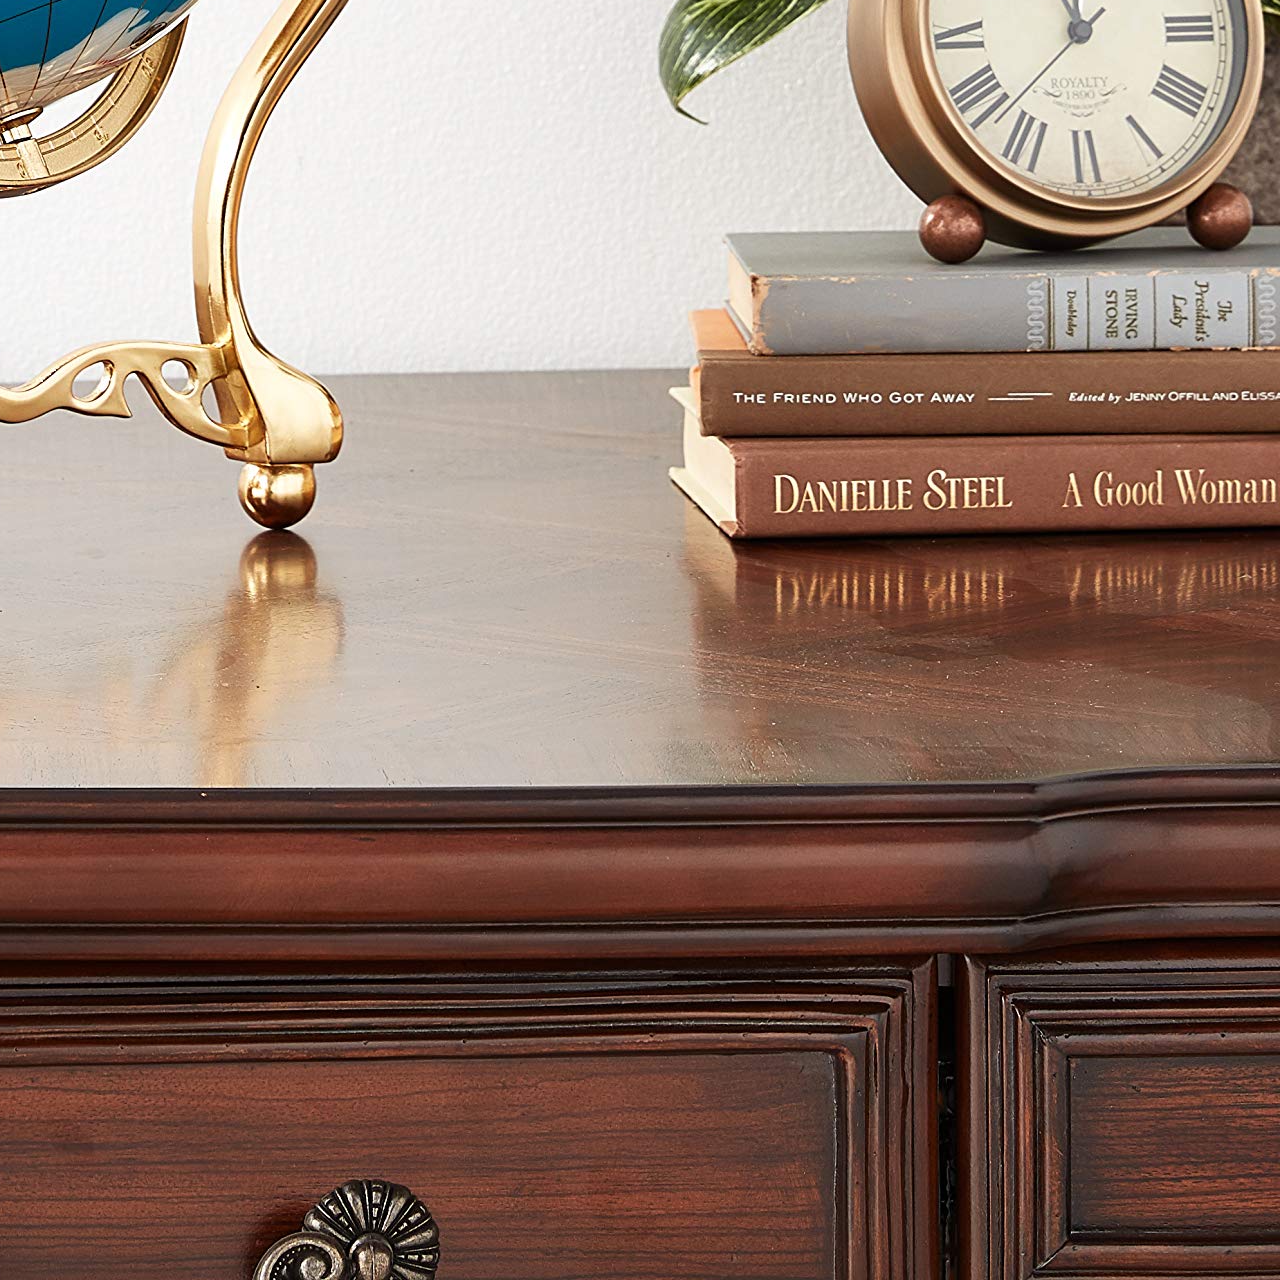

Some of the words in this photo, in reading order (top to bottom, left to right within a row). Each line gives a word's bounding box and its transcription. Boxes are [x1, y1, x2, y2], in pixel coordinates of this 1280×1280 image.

[1051, 76, 1109, 89] ROYALTY
[1065, 90, 1096, 100] 1890
[1065, 290, 1077, 338] Doubleday
[1104, 289, 1119, 339] STONE
[1124, 287, 1139, 340] IRVING
[1169, 294, 1188, 329] Lady
[1217, 299, 1233, 323] The
[733, 392, 766, 404] THE
[773, 392, 837, 404] FRIEND
[843, 392, 883, 404] WHO
[889, 391, 925, 404] GOT
[930, 391, 976, 404] AWAY
[1068, 391, 1106, 403] Edited
[1108, 392, 1122, 405] by
[1124, 391, 1166, 403] JENNY
[1168, 390, 1211, 402] OFFILL
[1211, 391, 1239, 402] AND
[773, 473, 913, 515] DANIELLE
[922, 468, 1013, 511] STEEL
[1061, 472, 1084, 508] A
[1093, 468, 1165, 508] Good
[1173, 468, 1278, 505] Woman
